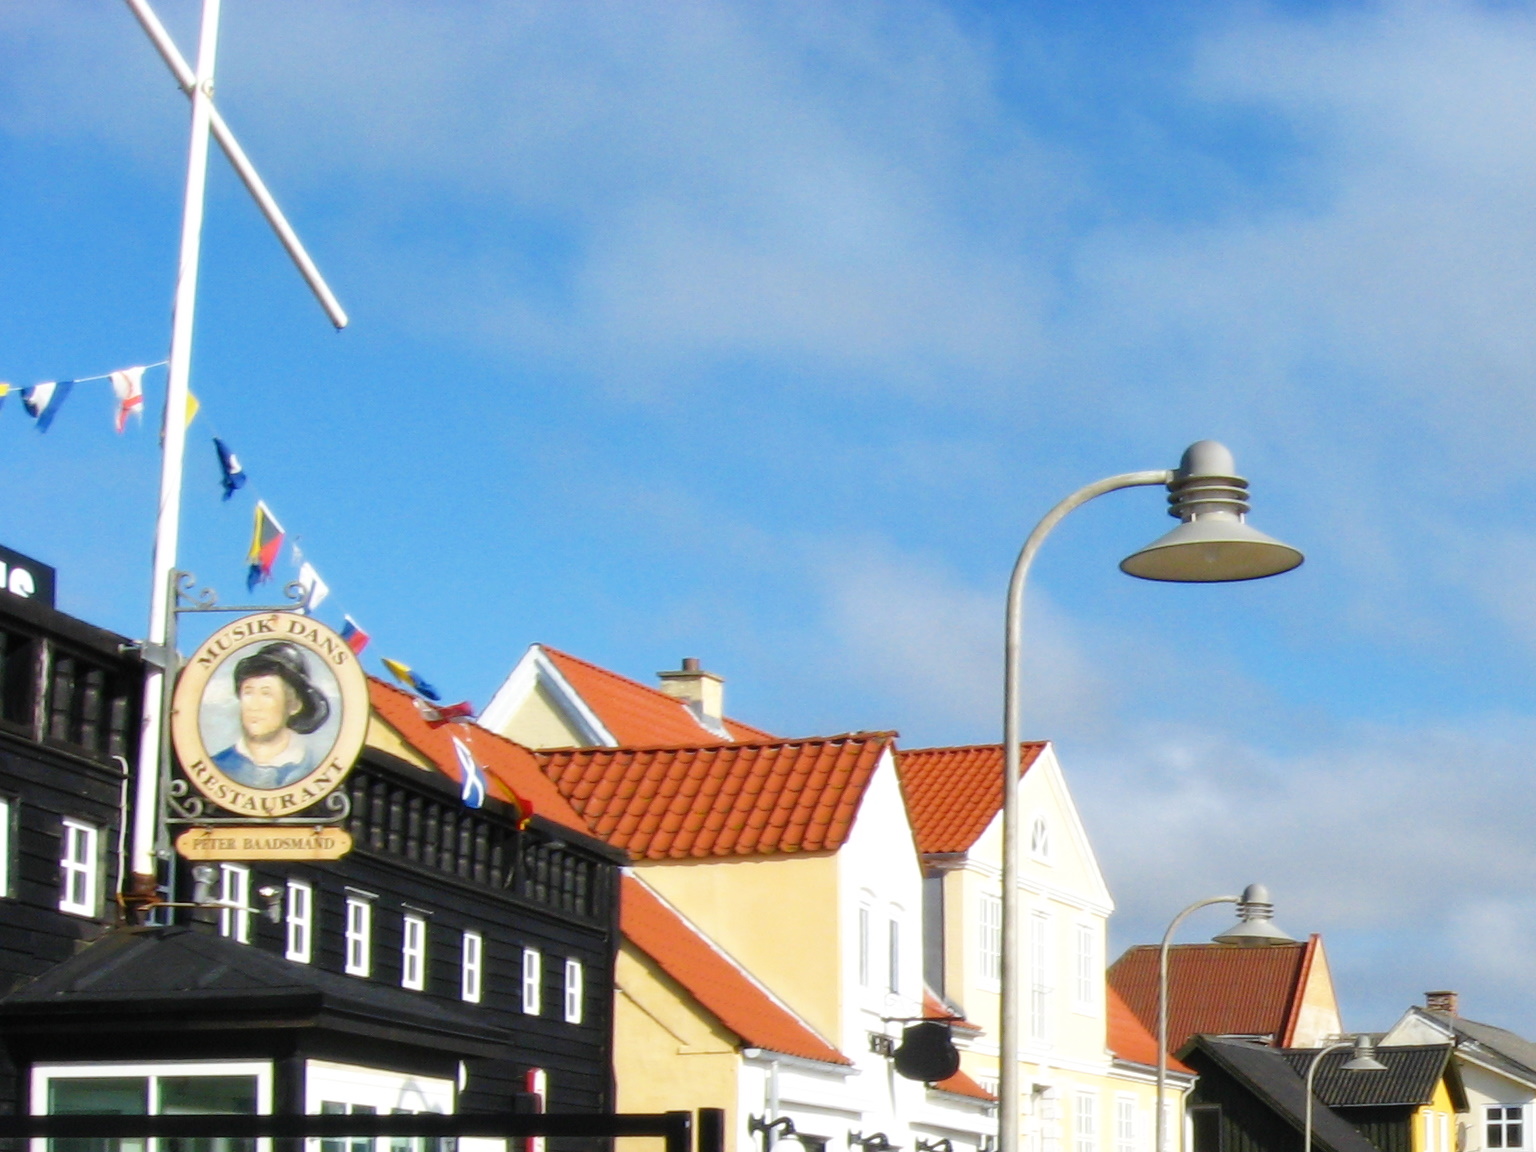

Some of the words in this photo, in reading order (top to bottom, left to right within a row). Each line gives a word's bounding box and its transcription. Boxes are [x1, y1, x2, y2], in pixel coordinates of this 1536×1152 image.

[197, 619, 276, 670] MUSIK
[287, 620, 348, 666] DANS
[190, 757, 345, 811] RESTAURANT
[193, 837, 236, 850] PETER
[243, 837, 335, 850] BAADSMAND
